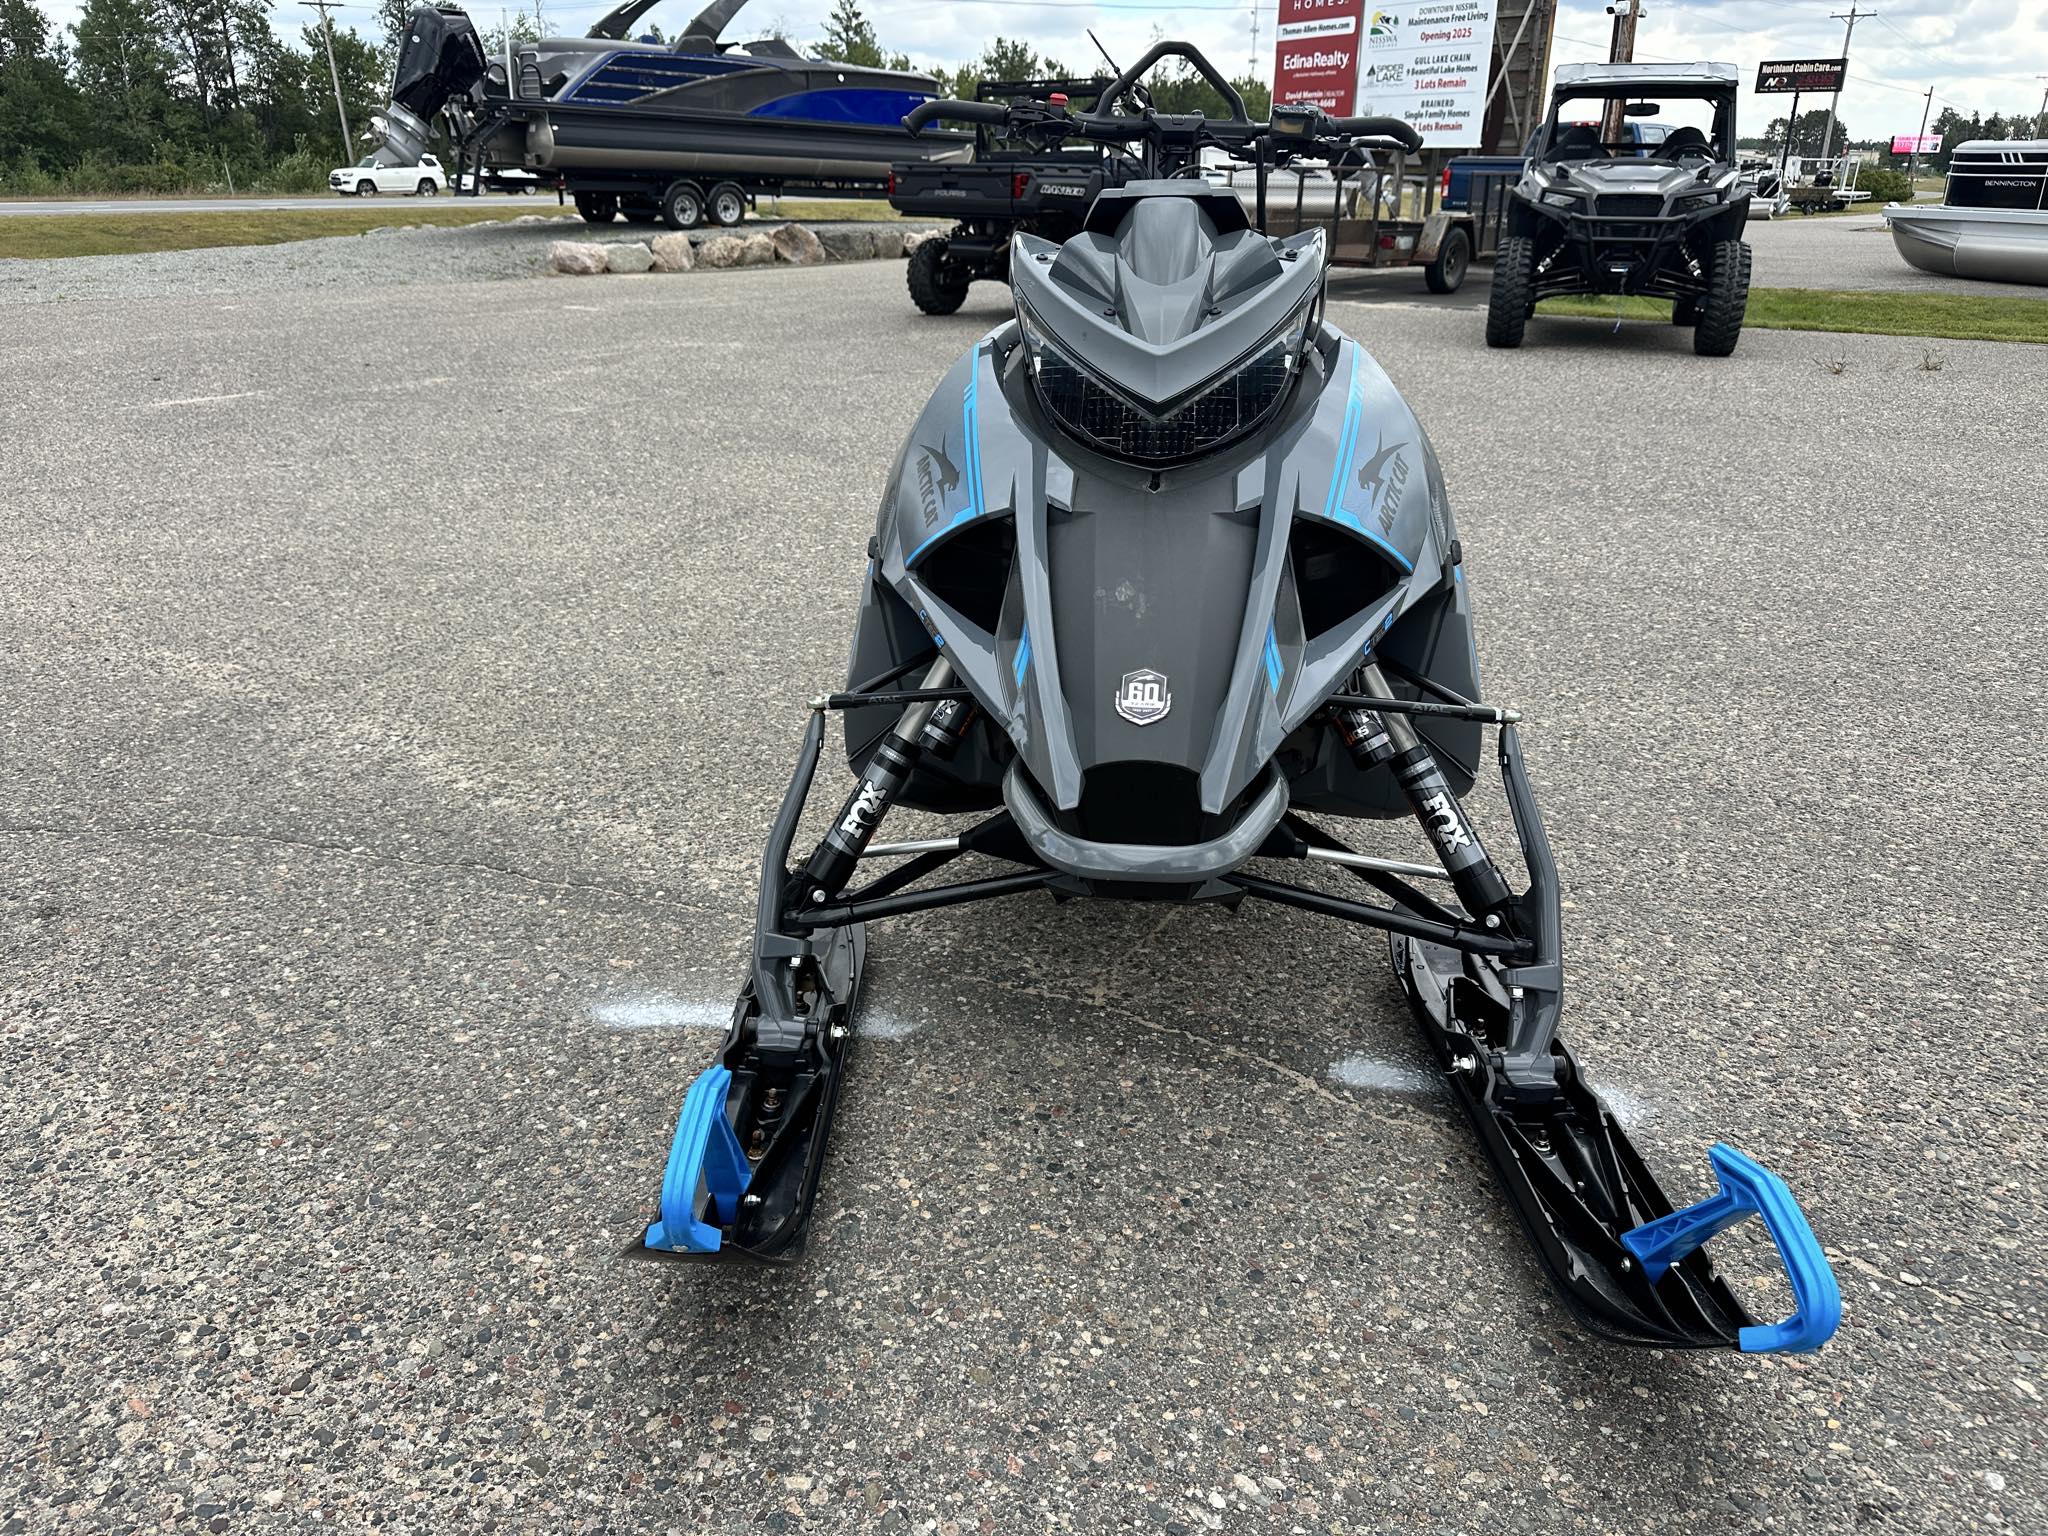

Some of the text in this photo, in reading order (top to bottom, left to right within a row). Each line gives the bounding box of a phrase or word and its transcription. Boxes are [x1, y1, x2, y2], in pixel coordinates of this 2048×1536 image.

[1419, 2, 1478, 15] DOWNTOWN NISSWA
[1408, 11, 1489, 26] Maintenance Free Living
[1368, 35, 1398, 44] NISSWA
[1421, 28, 1472, 43] Opening 2025
[1414, 53, 1472, 65] GULL LAKE CHAIN
[1376, 64, 1404, 72] SPIDER
[1406, 64, 1478, 77] 9 Beautiful Lake Homes
[1762, 64, 1794, 74] Northland
[1376, 71, 1404, 82] LAKE
[1414, 82, 1419, 90] 3
[1420, 80, 1436, 90] Lots
[1437, 77, 1466, 88] Remain
[1285, 91, 1302, 100] David
[1421, 99, 1455, 108] BRAINERD
[1404, 109, 1470, 121] Single Family Homes
[1419, 122, 1433, 132] Lots
[1435, 121, 1462, 130] Remain
[934, 189, 966, 197] POLARIS
[916, 454, 938, 528] ARCTIC CAT
[1378, 452, 1409, 536] ARCTIC CAT
[1128, 682, 1160, 702] 60
[1411, 703, 1448, 712] ATAC
[840, 779, 888, 839] FOX
[1422, 791, 1472, 855] FOX
